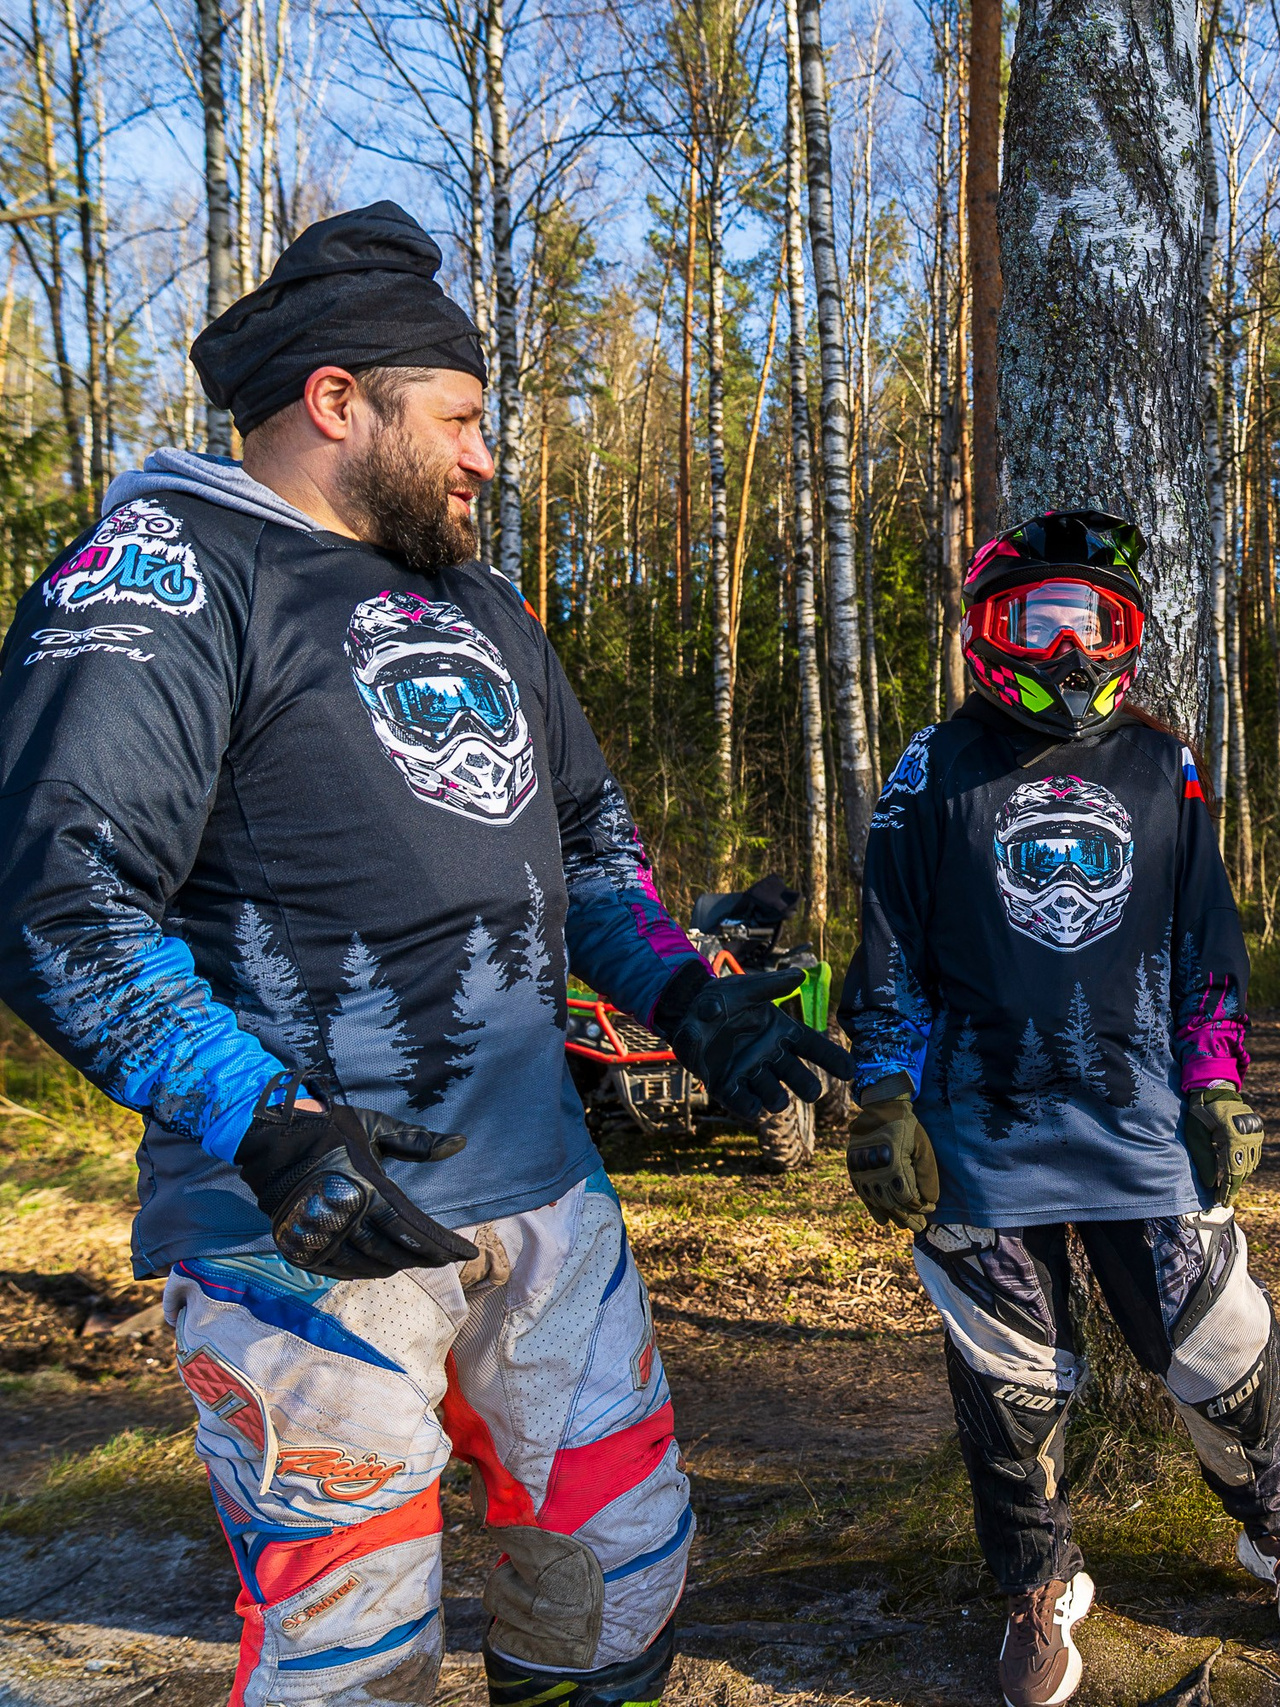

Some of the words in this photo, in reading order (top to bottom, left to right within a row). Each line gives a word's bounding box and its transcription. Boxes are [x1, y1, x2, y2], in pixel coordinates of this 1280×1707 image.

[993, 1384, 1066, 1412] thor
[1207, 1361, 1265, 1419] thor
[276, 1448, 405, 1501] Racing
